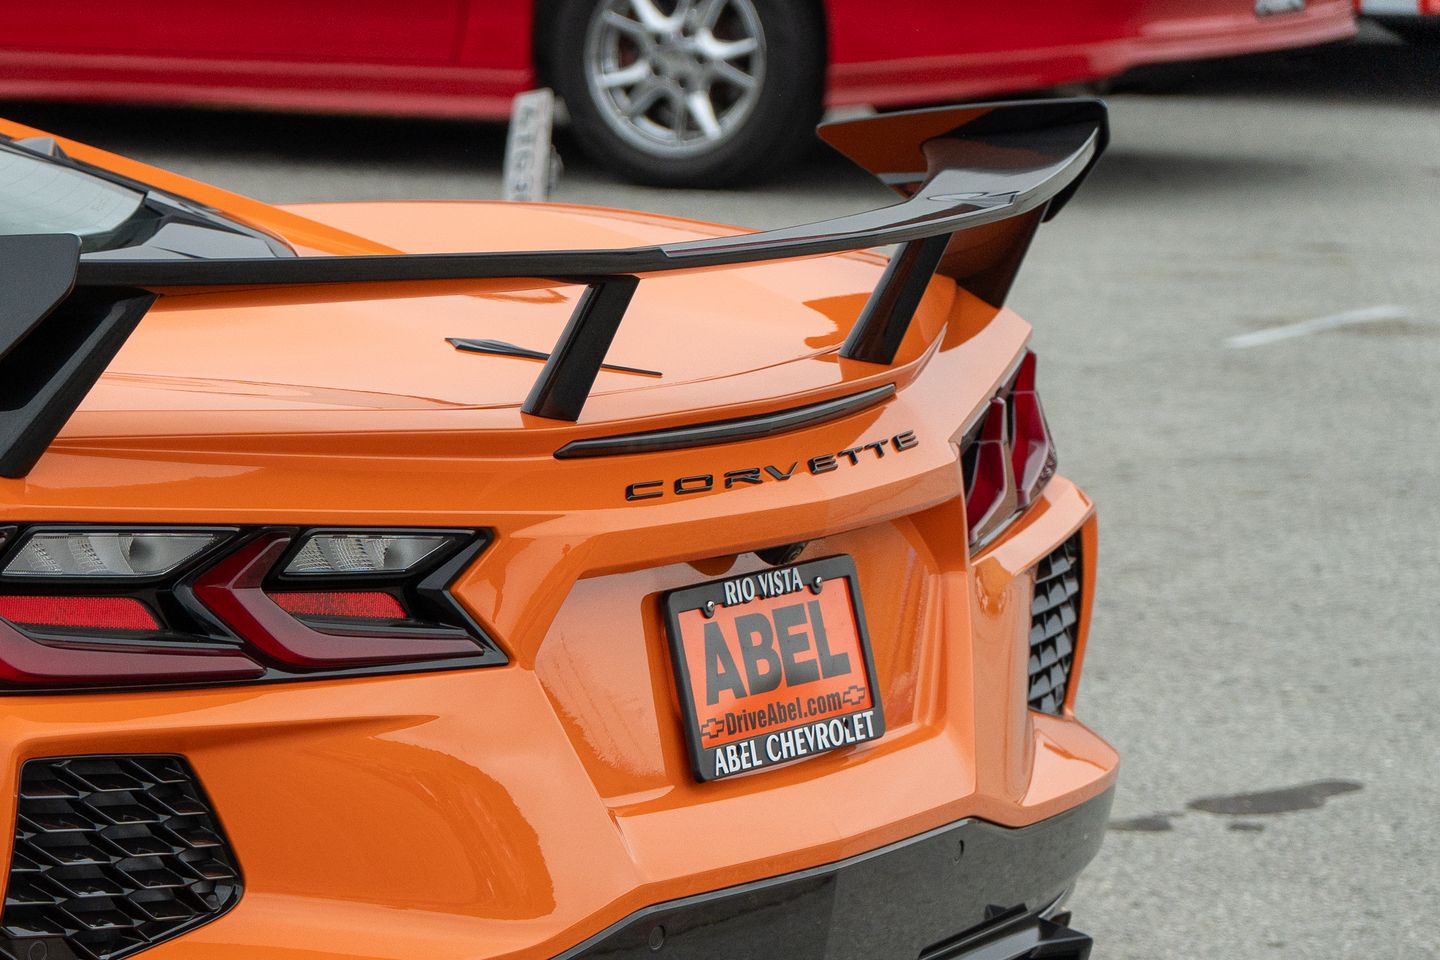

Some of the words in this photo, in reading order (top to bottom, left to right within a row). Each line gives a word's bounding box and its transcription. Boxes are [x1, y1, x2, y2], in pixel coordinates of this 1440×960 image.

[624, 430, 920, 501] CORVETTE
[724, 576, 755, 605] RIO
[758, 567, 804, 598] VISTA
[703, 599, 852, 706] ABEL
[715, 739, 763, 777] ABEL
[766, 710, 875, 762] CHEVROLET
[726, 691, 844, 736] DriveAbel.com
